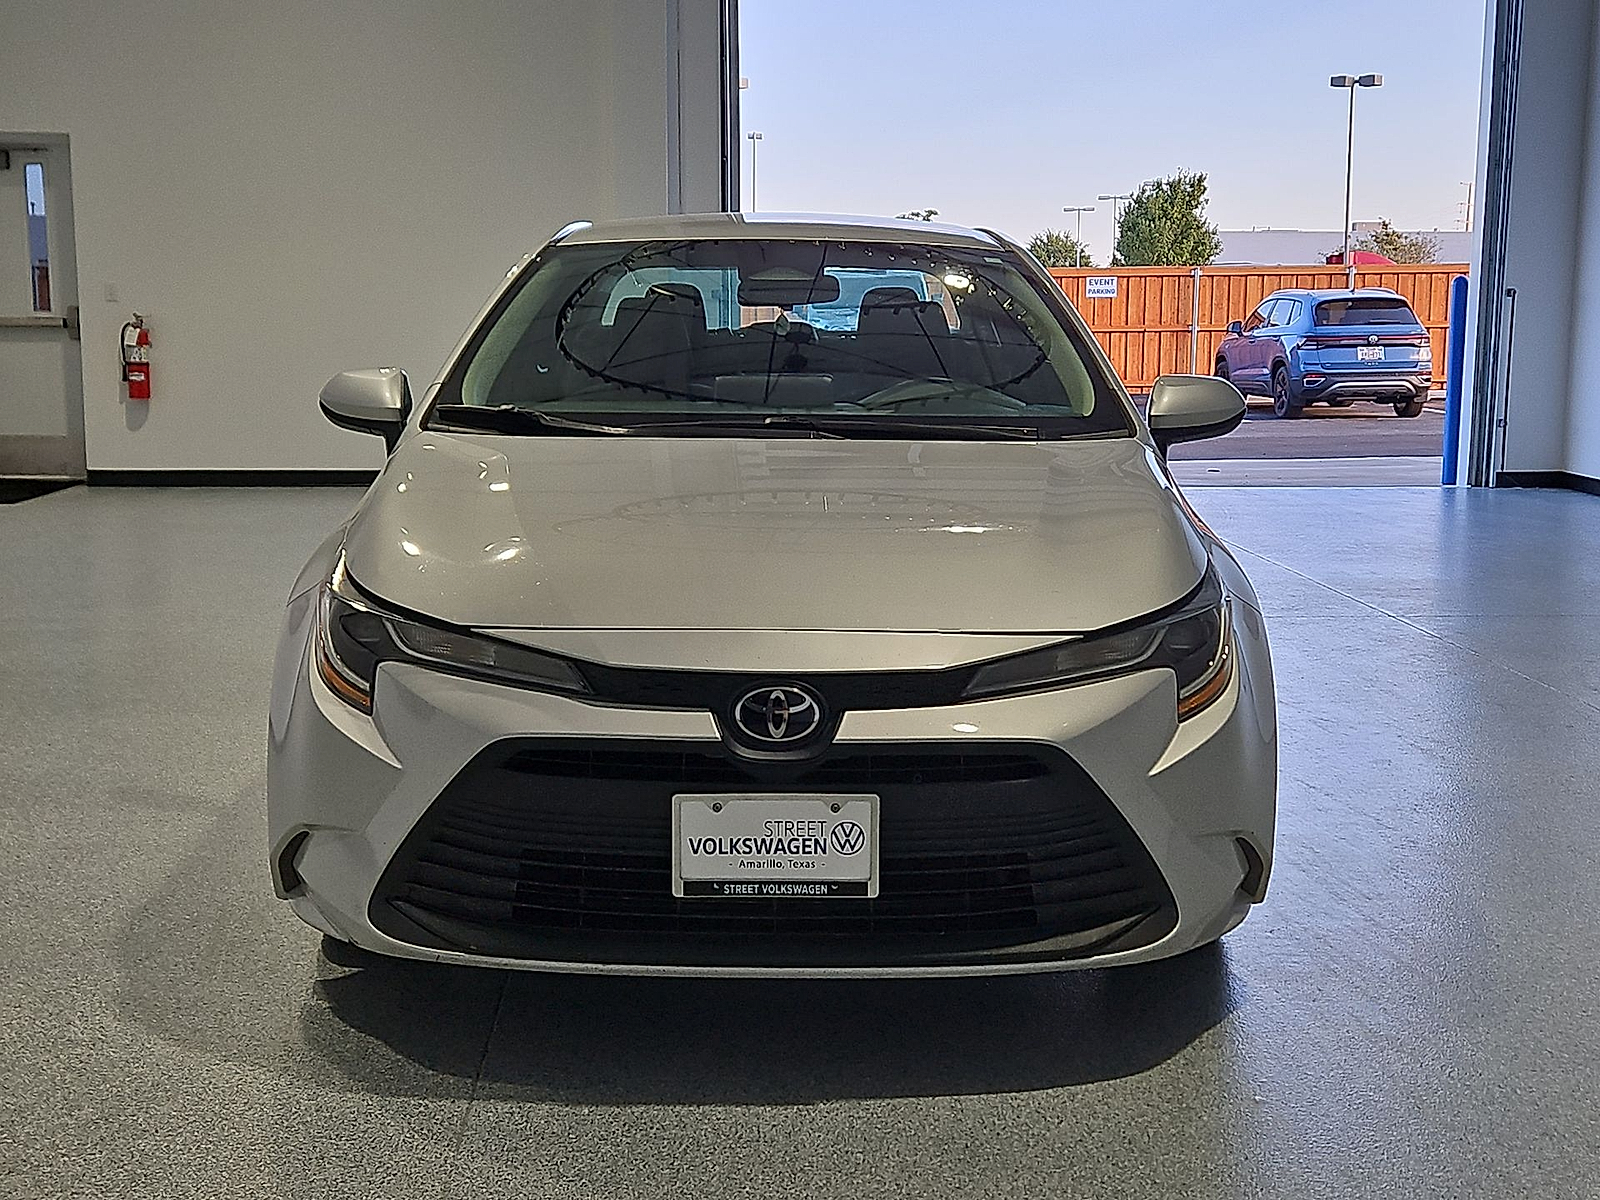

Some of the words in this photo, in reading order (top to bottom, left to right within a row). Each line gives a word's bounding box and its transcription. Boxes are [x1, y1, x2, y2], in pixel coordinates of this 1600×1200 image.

[1088, 278, 1115, 286] EVENT
[764, 820, 828, 838] STREET
[688, 837, 828, 855] VOLKSWAGEN
[738, 859, 785, 869] Amarillo,
[787, 859, 816, 869] Texas
[723, 884, 759, 894] STREET
[761, 884, 828, 895] VOLKSWAGEN
